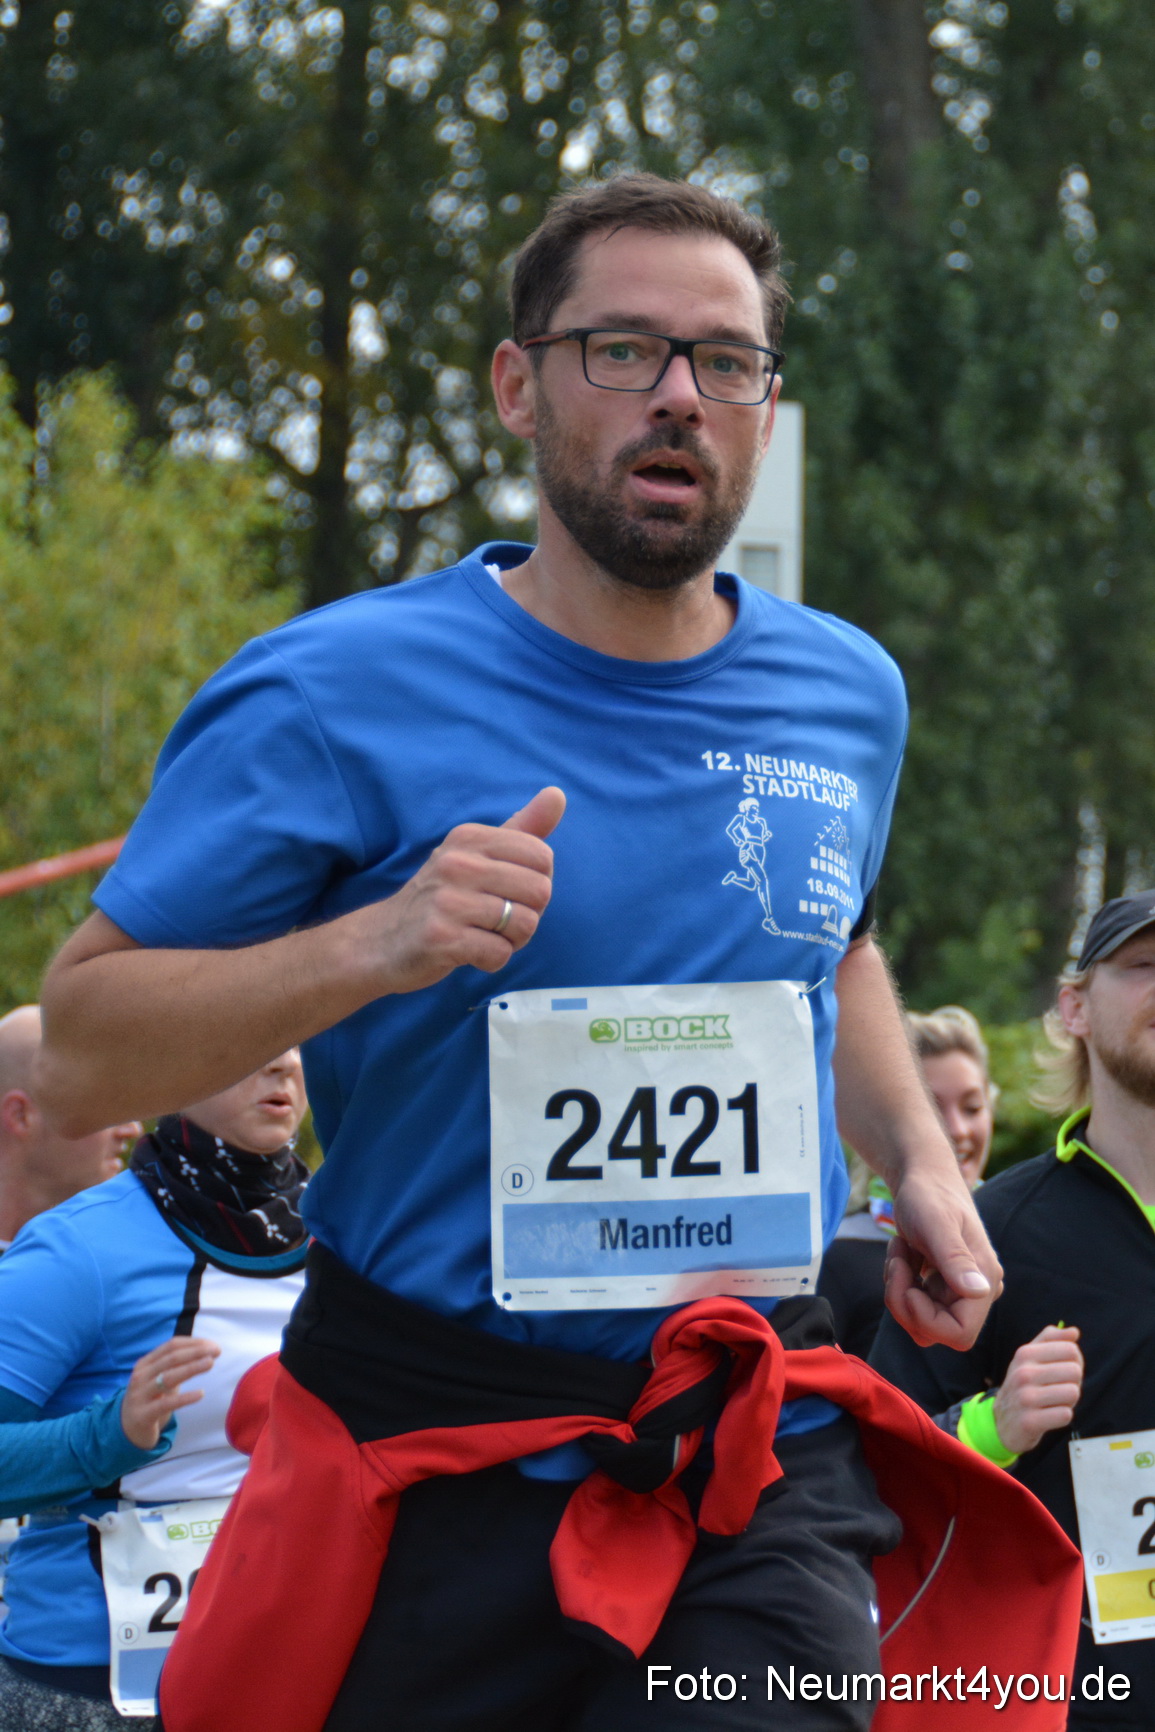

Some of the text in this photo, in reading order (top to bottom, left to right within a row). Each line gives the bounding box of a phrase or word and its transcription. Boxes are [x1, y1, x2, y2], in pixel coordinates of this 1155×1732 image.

[701, 750, 859, 803] 12. NEUMARKTER
[742, 774, 851, 812] STADTLAUF
[623, 1014, 732, 1042] BOCK
[624, 1041, 734, 1053] inspired by smart concepts
[544, 1082, 760, 1182] 2421
[511, 1173, 524, 1189] D
[600, 1213, 733, 1250] Manfred
[124, 1627, 133, 1640] D
